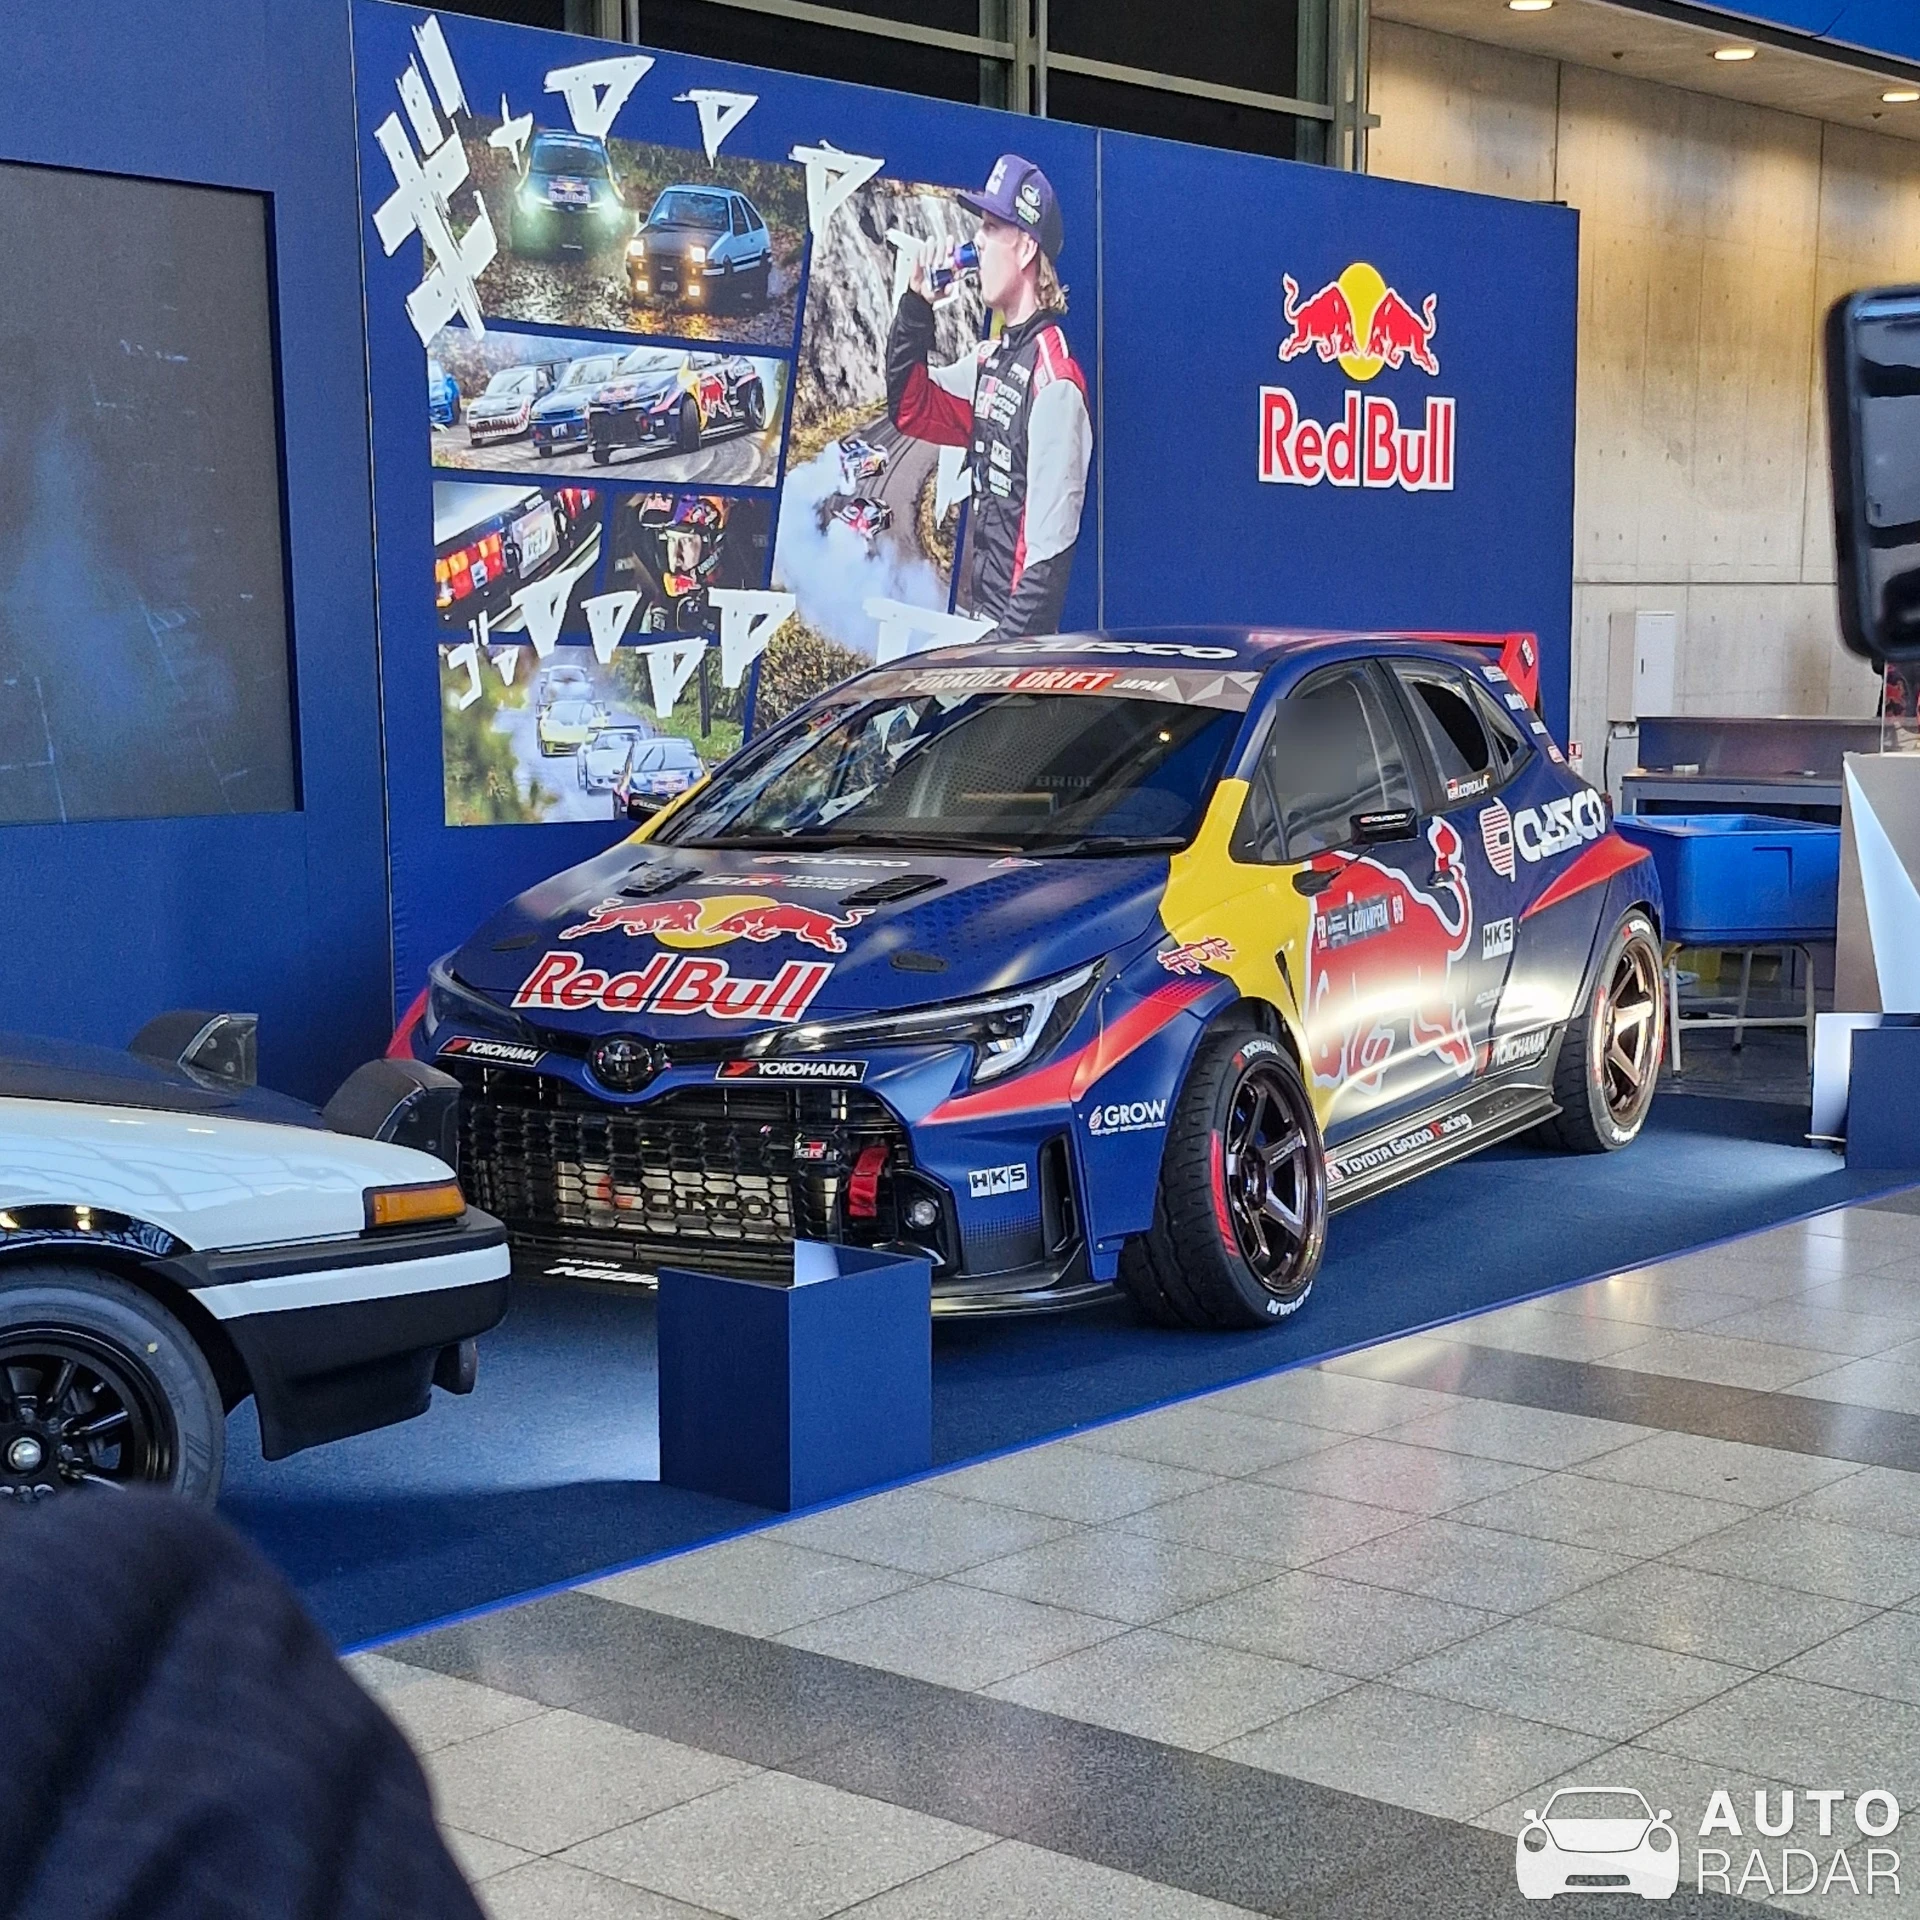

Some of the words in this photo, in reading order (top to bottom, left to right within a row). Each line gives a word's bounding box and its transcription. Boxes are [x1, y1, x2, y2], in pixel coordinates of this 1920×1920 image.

[1259, 385, 1361, 487] Red
[1363, 396, 1455, 491] Bull
[996, 642, 1238, 659] CUSCO
[902, 670, 1013, 692] FORMULA
[1020, 671, 1112, 690] DRIFT
[1113, 678, 1169, 692] JAPAN
[1512, 788, 1606, 863] CUSCO
[1483, 921, 1512, 948] HKS
[511, 951, 679, 1012] Red
[648, 956, 835, 1023] Bull
[466, 1041, 539, 1061] YOKOHAMA
[758, 1062, 858, 1077] YOKOHAMA
[1103, 1099, 1167, 1126] GROW
[1338, 1146, 1393, 1175] TOYOTA
[1391, 1128, 1434, 1155] GAZOO
[1429, 1113, 1472, 1141] Racing
[970, 1167, 1025, 1189] HKS
